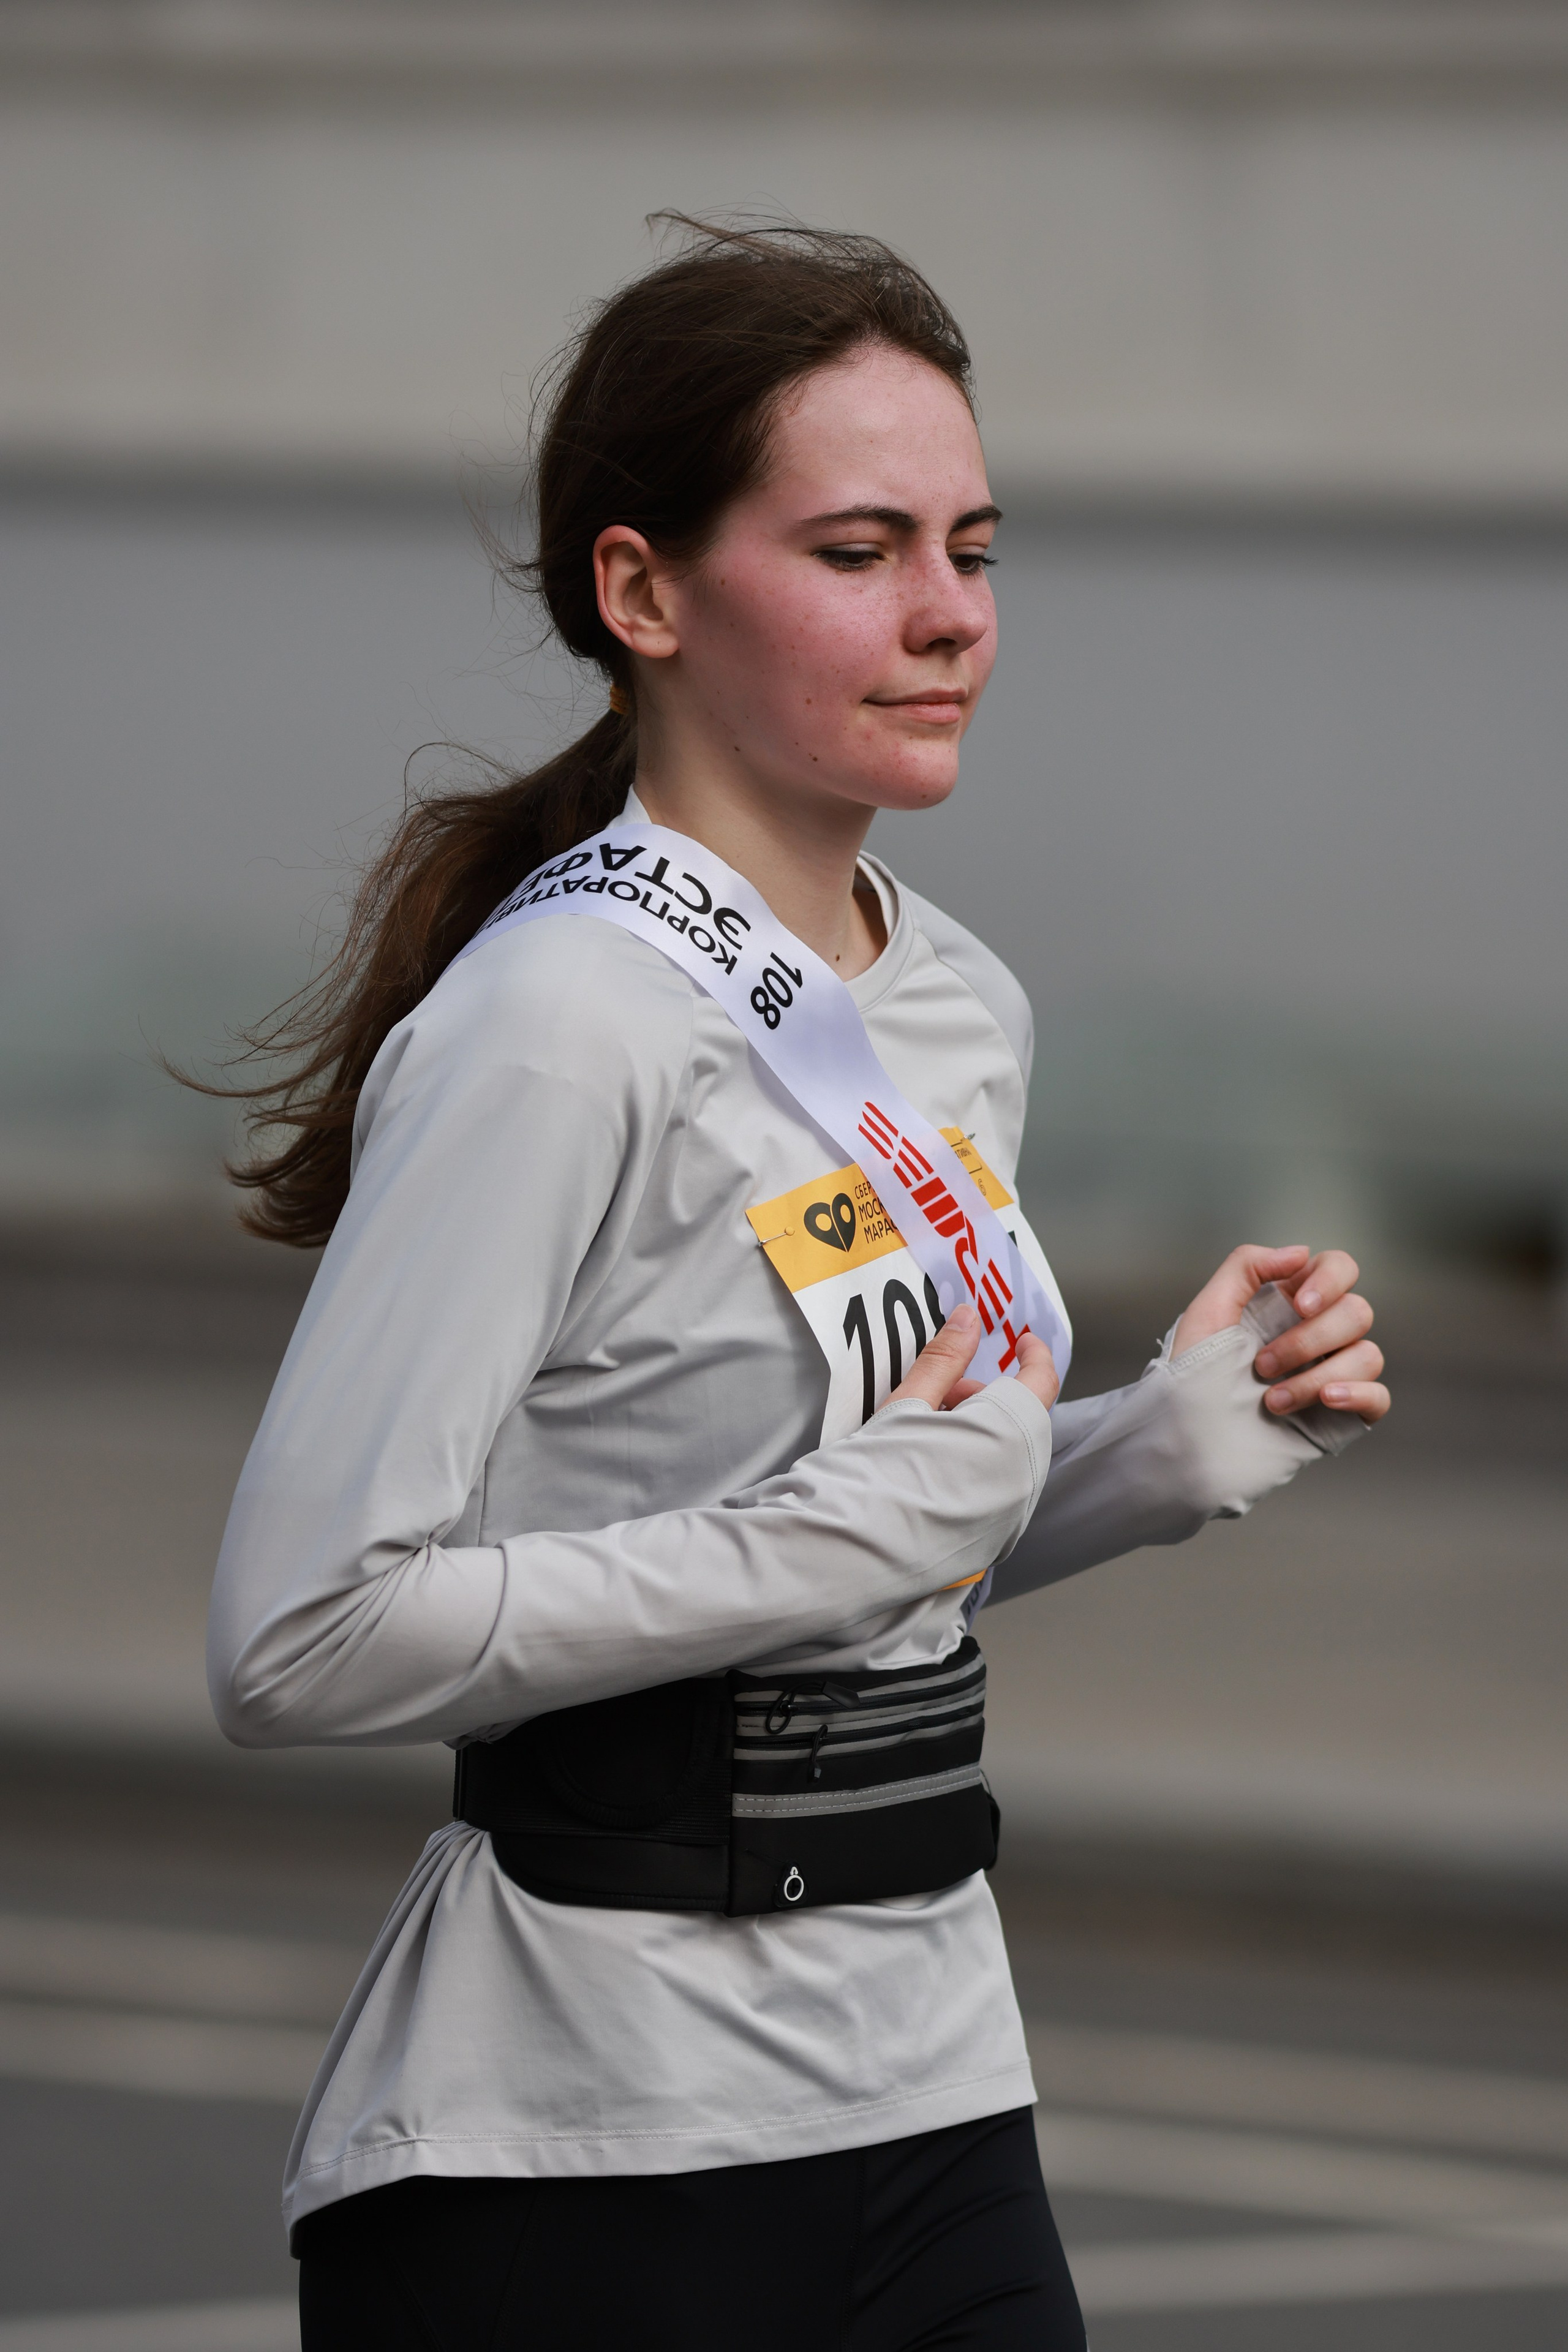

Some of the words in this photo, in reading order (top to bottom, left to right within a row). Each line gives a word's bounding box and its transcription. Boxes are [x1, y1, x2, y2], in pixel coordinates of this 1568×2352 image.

[750, 952, 803, 1030] 108
[854, 1181, 875, 1199] СБЕР
[858, 1197, 887, 1222] МОСК
